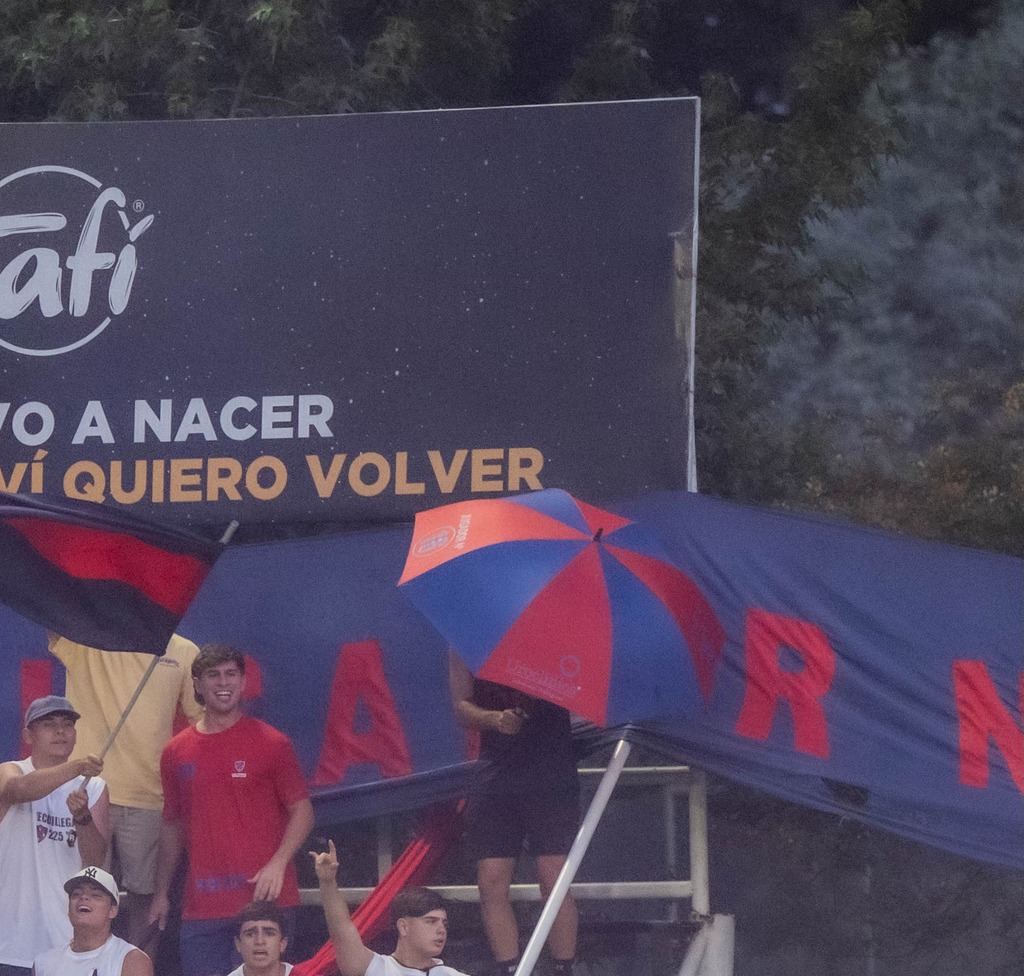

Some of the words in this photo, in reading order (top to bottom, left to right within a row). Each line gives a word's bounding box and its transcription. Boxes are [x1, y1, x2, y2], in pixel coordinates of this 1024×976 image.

[72, 400, 115, 445] A
[133, 394, 334, 443] NACER
[63, 455, 288, 504] QUIERO
[306, 447, 544, 499] VOLVER
